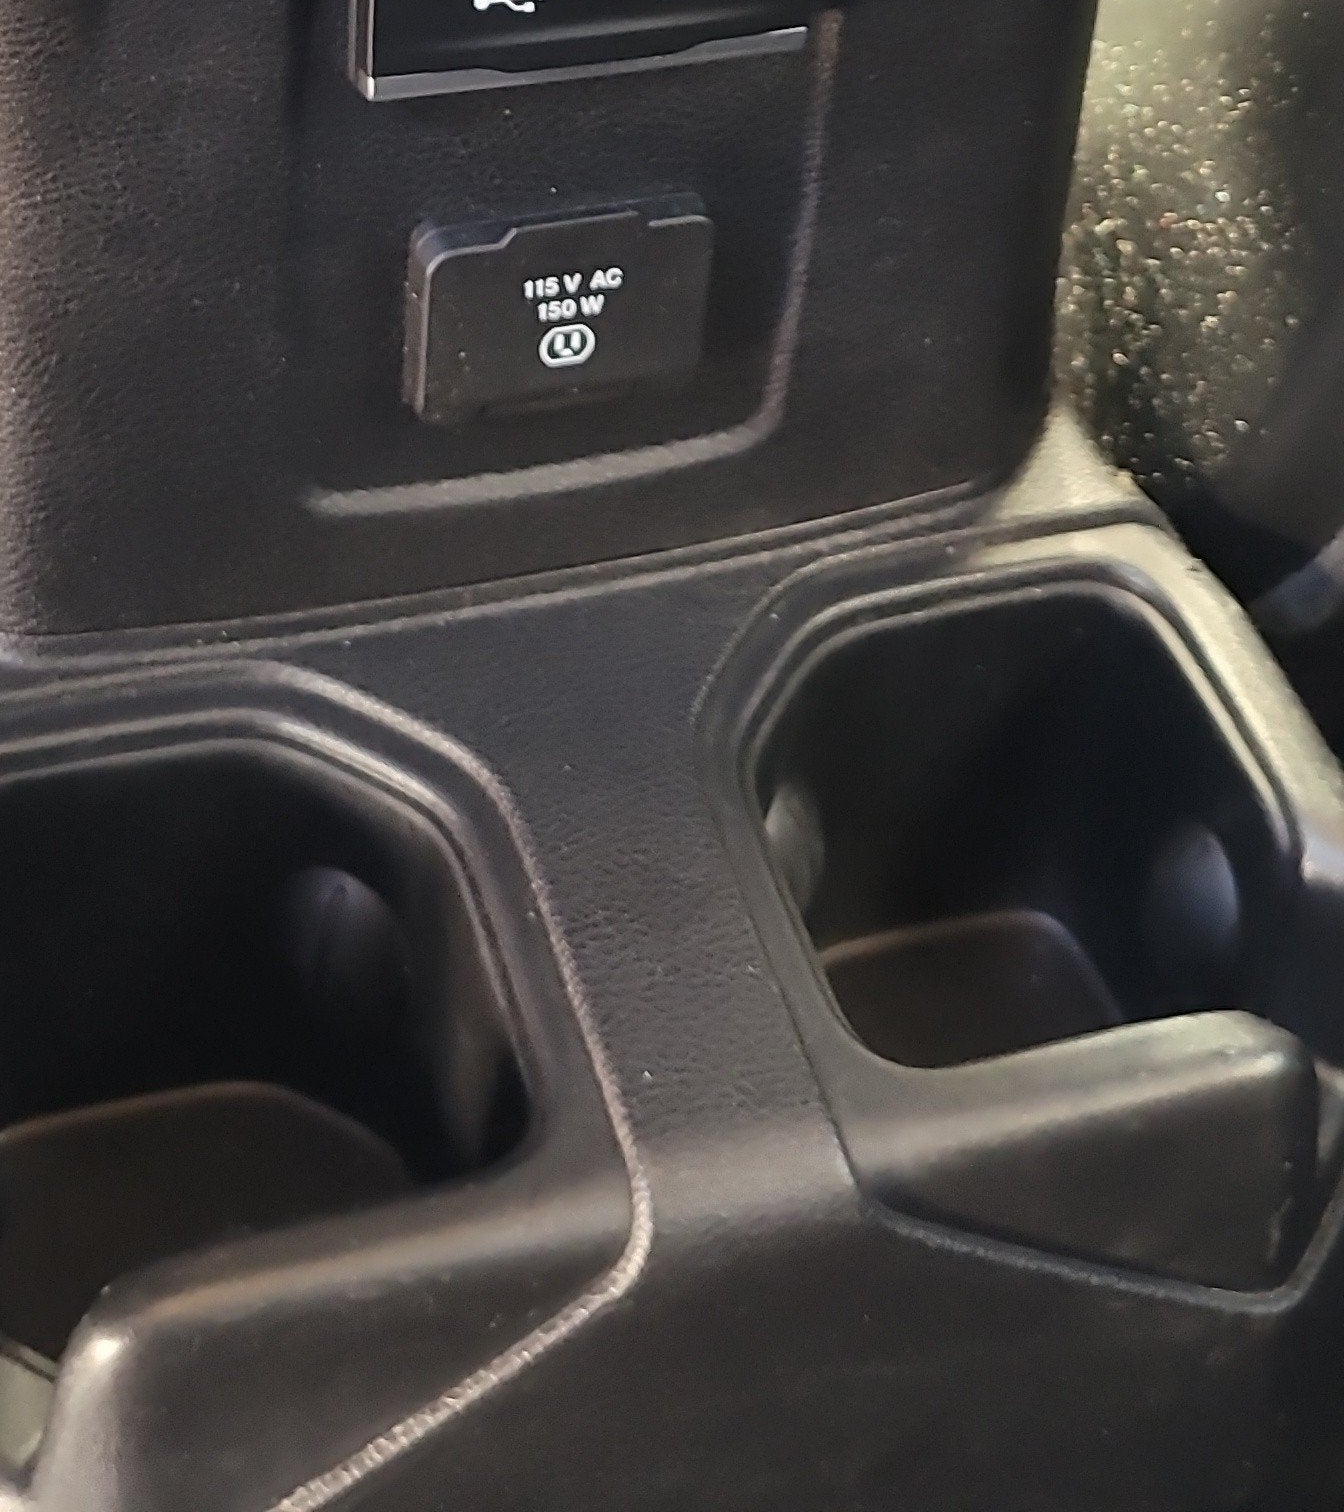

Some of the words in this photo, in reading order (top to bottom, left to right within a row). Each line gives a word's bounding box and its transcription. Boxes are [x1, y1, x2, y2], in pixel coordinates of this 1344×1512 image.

[524, 276, 559, 299] 115
[563, 273, 582, 293] V
[590, 267, 624, 290] AC
[538, 299, 577, 321] 150
[580, 294, 605, 316] W
